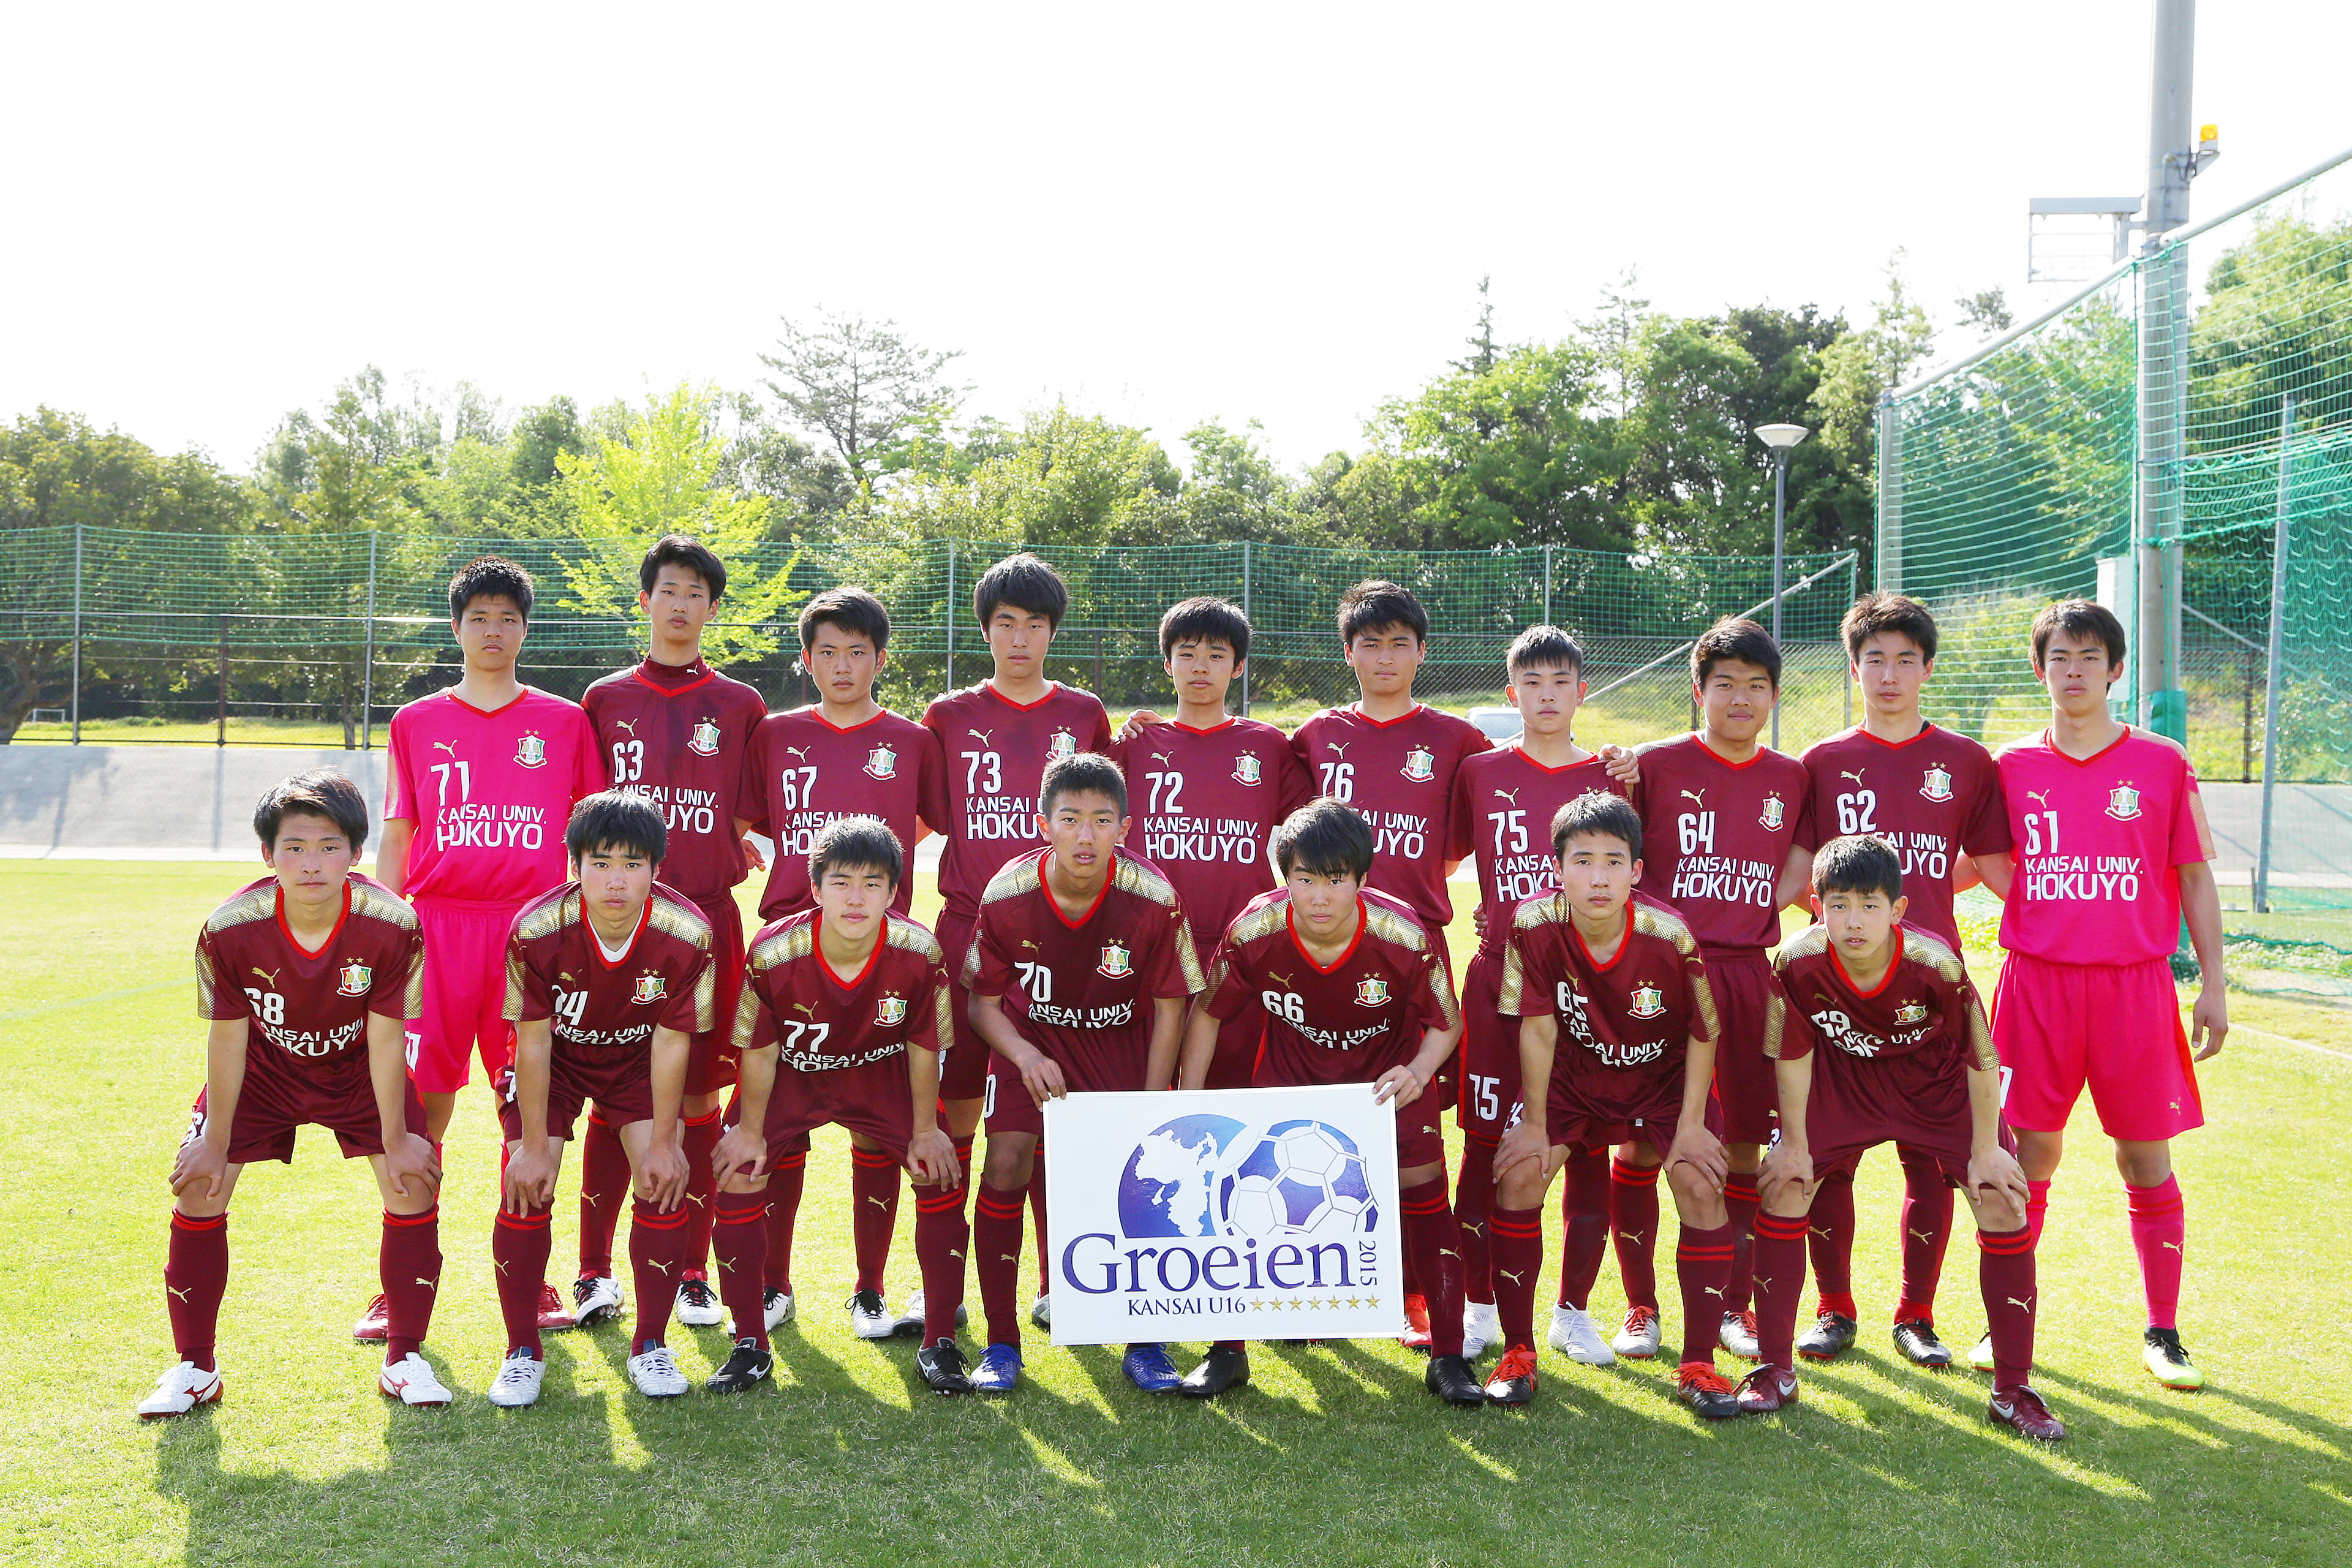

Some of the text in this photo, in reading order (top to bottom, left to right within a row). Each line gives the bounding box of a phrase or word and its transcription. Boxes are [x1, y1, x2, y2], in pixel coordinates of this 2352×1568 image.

[612, 739, 644, 783] 63
[961, 752, 1001, 794] 73
[431, 761, 470, 806] 71
[782, 766, 817, 810] 67
[1145, 771, 1183, 814] 72
[1319, 762, 1354, 803] 76
[437, 804, 496, 824] KANSAI
[965, 797, 1030, 812] KANSAI
[1837, 790, 1877, 834] 62
[437, 821, 543, 851] HOKUYO
[967, 813, 1038, 840] HOKU
[1144, 816, 1261, 839] KANSAI UNIV.
[1385, 812, 1429, 834] UNIV.
[1488, 810, 1528, 856] 75
[1678, 811, 1715, 855] 64
[2024, 811, 2059, 855] 61
[1145, 833, 1256, 864] HOKUYO
[1494, 854, 1555, 875] KANSA
[1677, 856, 1737, 874] KANSAI
[2025, 856, 2143, 874] KANSAI UNIV.
[1672, 873, 1772, 907] HOKUYO
[2027, 873, 2138, 901] HOKUYO
[1014, 962, 1052, 1002] 70
[1262, 990, 1305, 1023] 66
[1558, 981, 1588, 1022] 65
[260, 1021, 320, 1041] ANSAI
[784, 1020, 829, 1053] 77
[782, 1045, 856, 1063] KANSAI
[1469, 1073, 1500, 1120] 75
[1061, 1233, 1356, 1294] Groeien
[1359, 1240, 1377, 1286] 2015
[1128, 1296, 1246, 1316] KANSAI U16
